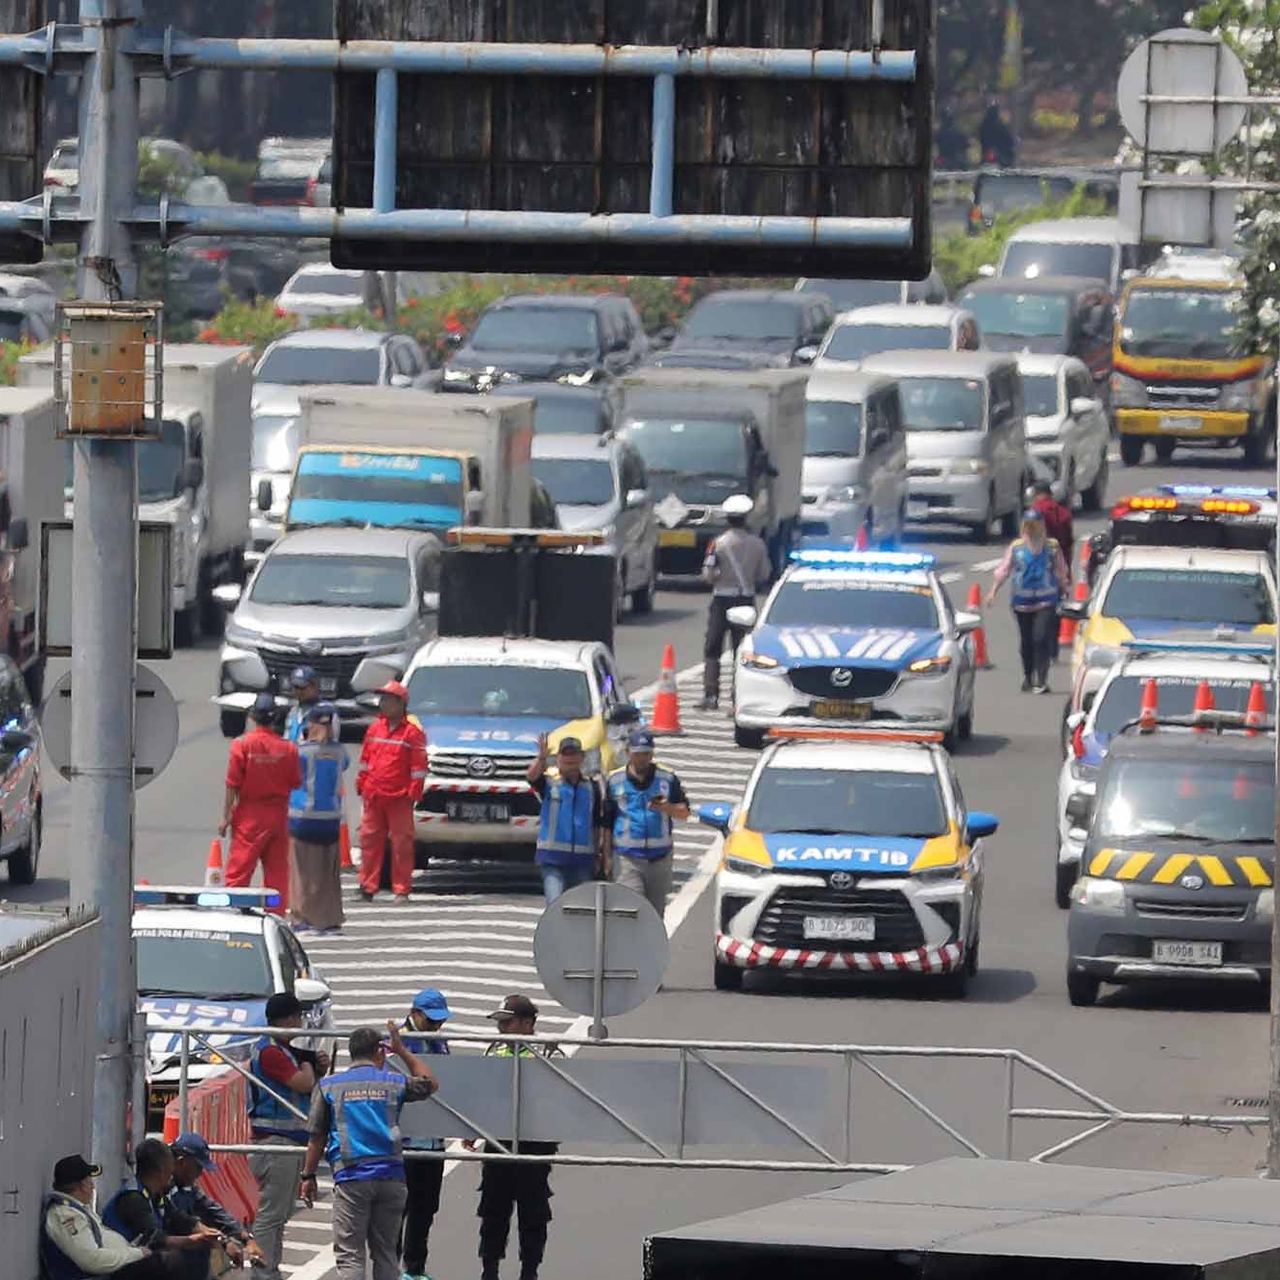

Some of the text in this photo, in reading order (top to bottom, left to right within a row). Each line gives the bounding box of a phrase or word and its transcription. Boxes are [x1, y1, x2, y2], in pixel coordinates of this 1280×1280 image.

[776, 847, 909, 866] KAMTIB
[131, 928, 157, 939] ANTAS
[138, 1001, 248, 1022] LISI
